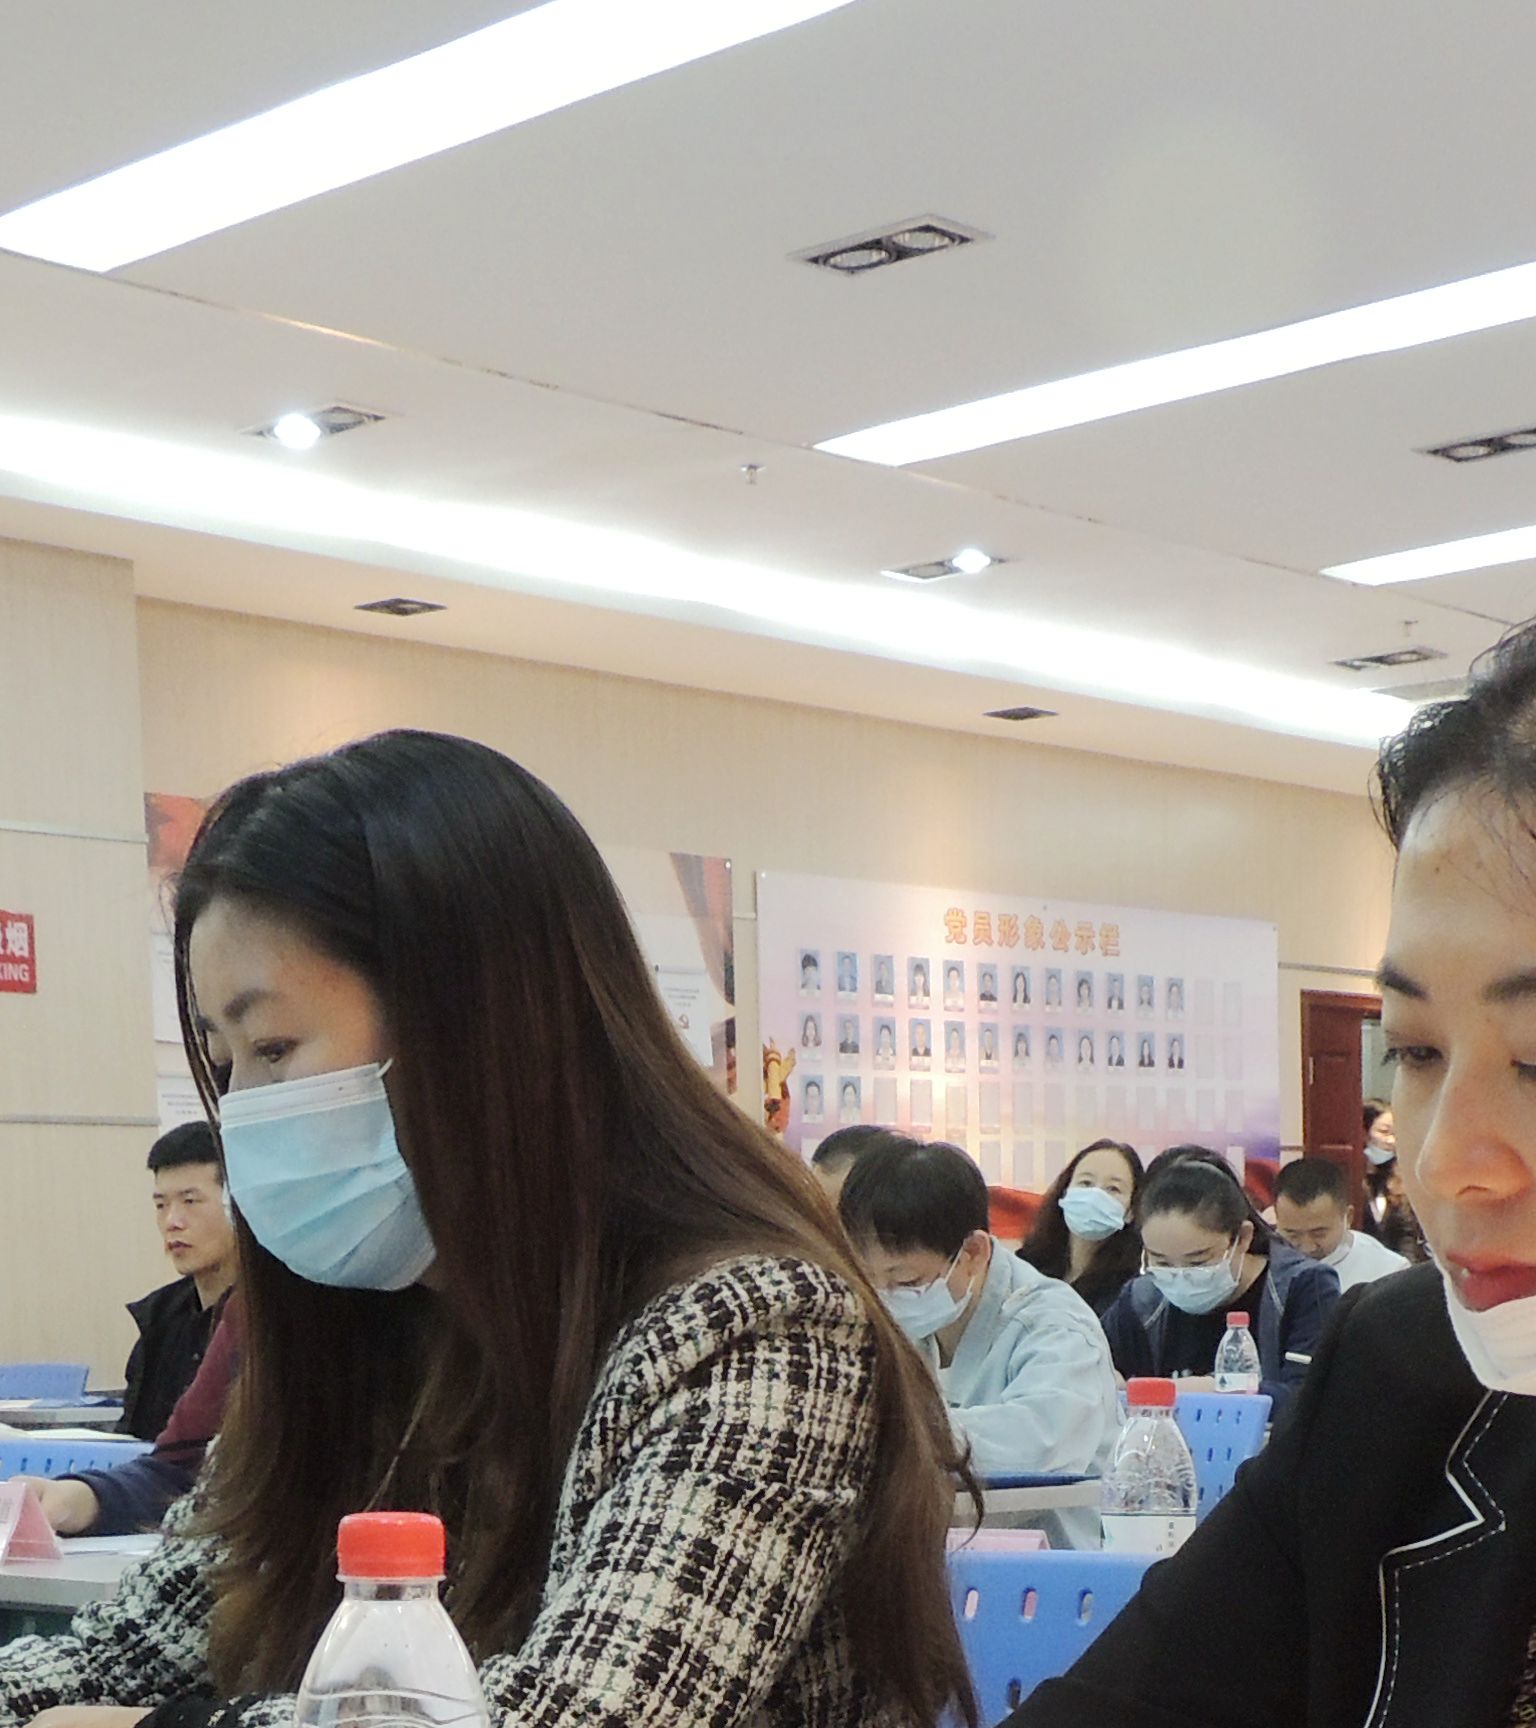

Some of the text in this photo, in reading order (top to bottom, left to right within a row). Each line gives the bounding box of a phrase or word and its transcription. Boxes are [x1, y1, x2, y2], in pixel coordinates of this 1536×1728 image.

[944, 906, 1121, 957] 党员形象公示栏
